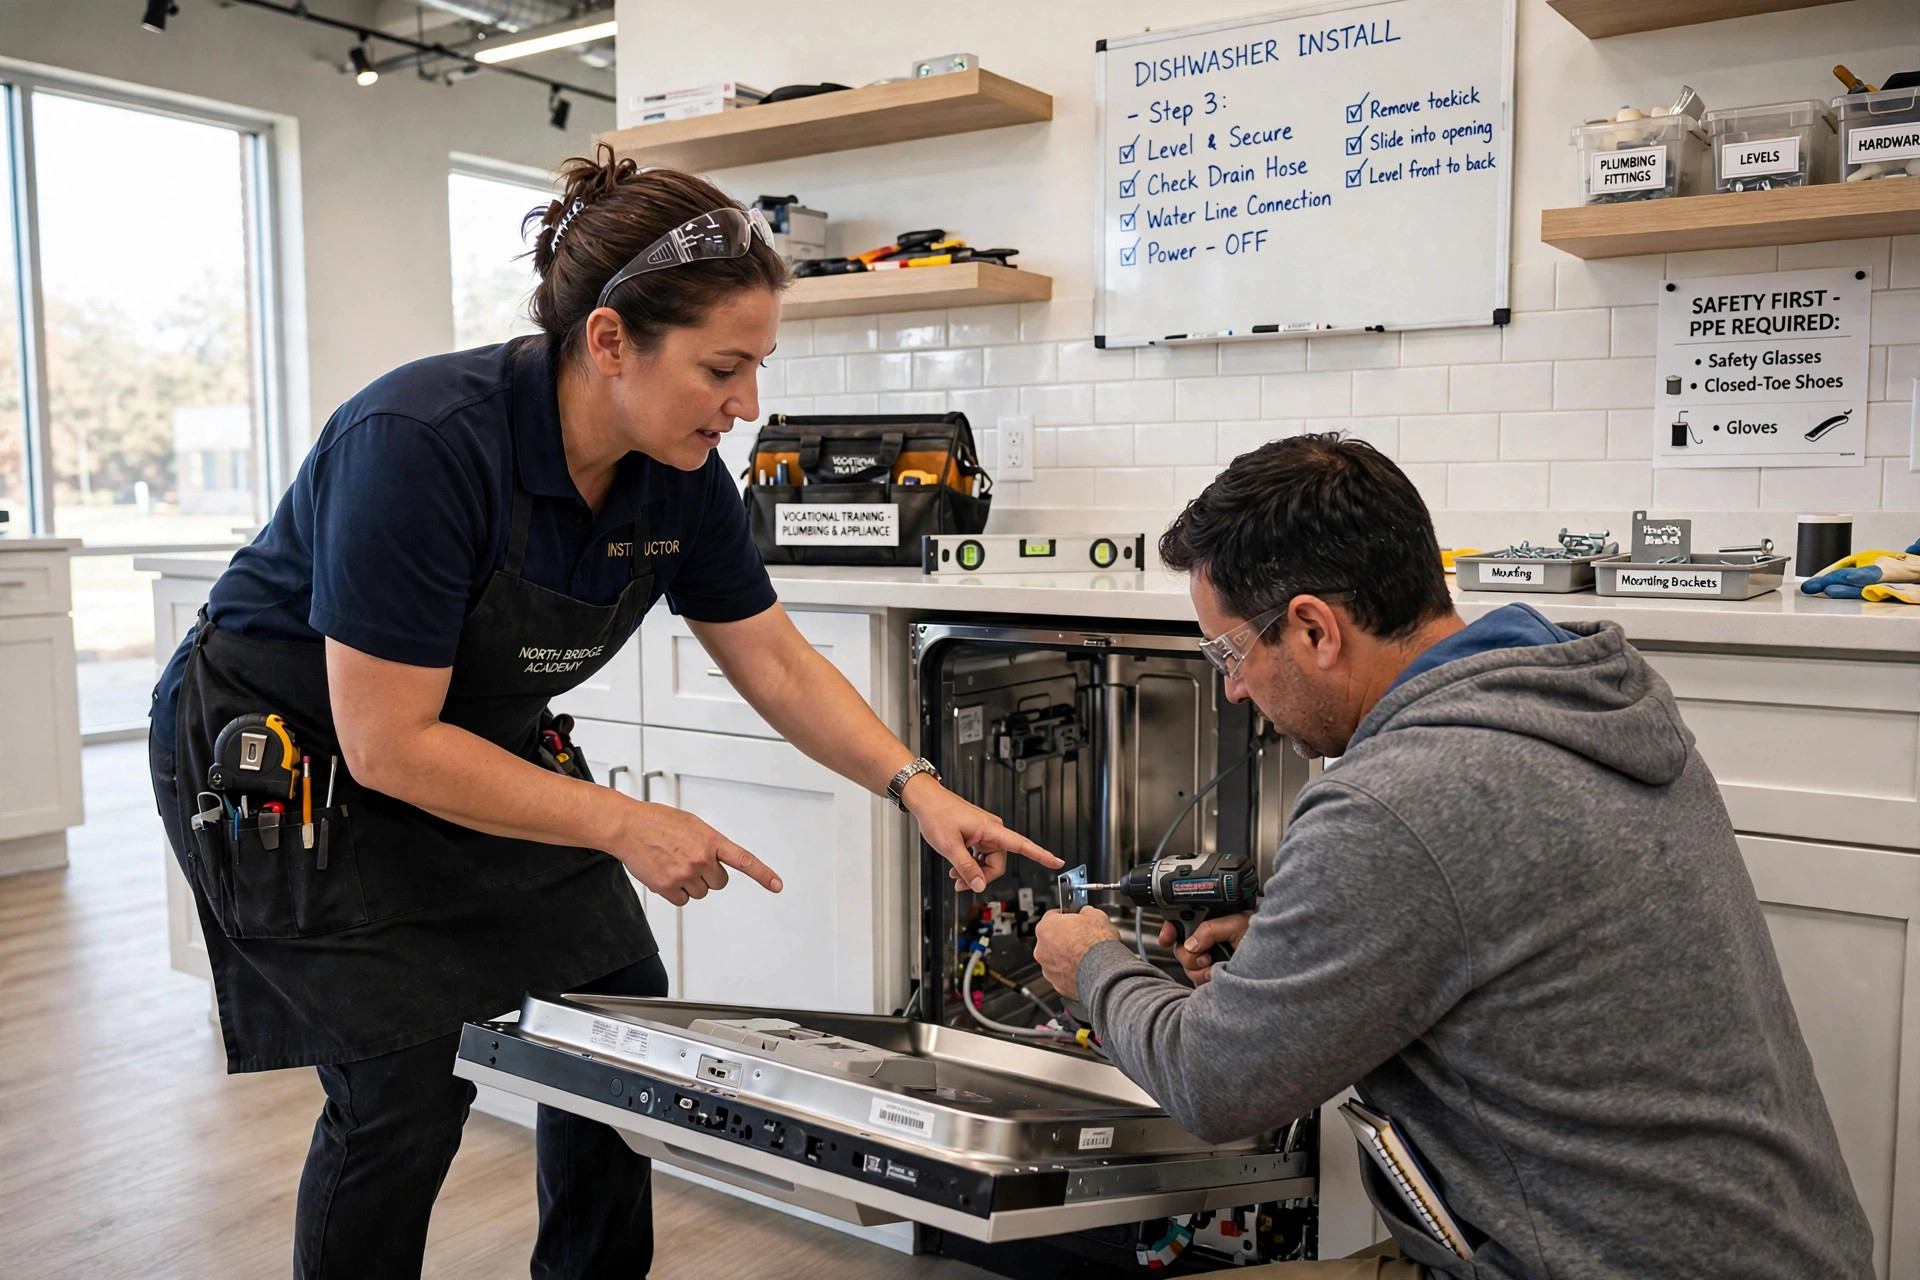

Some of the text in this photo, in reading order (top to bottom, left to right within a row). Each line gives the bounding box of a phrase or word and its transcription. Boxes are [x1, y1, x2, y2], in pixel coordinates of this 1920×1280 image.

[1135, 19, 1402, 87] DISHWASHER INSTALL
[1149, 100, 1194, 126] Step
[1204, 92, 1227, 115] 3:
[1370, 86, 1481, 119] Remove toekick
[1148, 125, 1293, 161] Level & Secure
[1370, 120, 1493, 151] Slide into opening
[1858, 134, 1920, 151] HARDWAR
[1369, 151, 1496, 184] Level front to back
[1600, 154, 1656, 171] PLUMBING
[1740, 150, 1780, 165] LEVELS
[1147, 155, 1308, 196] Check Drain Hose
[1604, 170, 1652, 185] FITTINGS
[1147, 189, 1332, 229] Water Line Connection
[1148, 241, 1197, 264] Power
[1225, 229, 1269, 255] OFF
[1692, 293, 1766, 315] SAFETY
[1771, 289, 1828, 310] FIRST
[1690, 313, 1841, 337] PPE REQUIRED:
[1708, 350, 1822, 370] Safety Glasses
[1704, 374, 1843, 393] Closed-Toe Shoes
[1726, 419, 1778, 435] Gloves
[782, 511, 841, 522] VOCATIONAL
[841, 511, 885, 522] TRAINING
[782, 525, 830, 537] PLUMBING
[840, 525, 891, 537] APPLIANCE
[607, 540, 680, 557] INSTUCTOR
[518, 645, 605, 661] NORTH BRIDGE
[523, 660, 584, 674] ACADEMY
